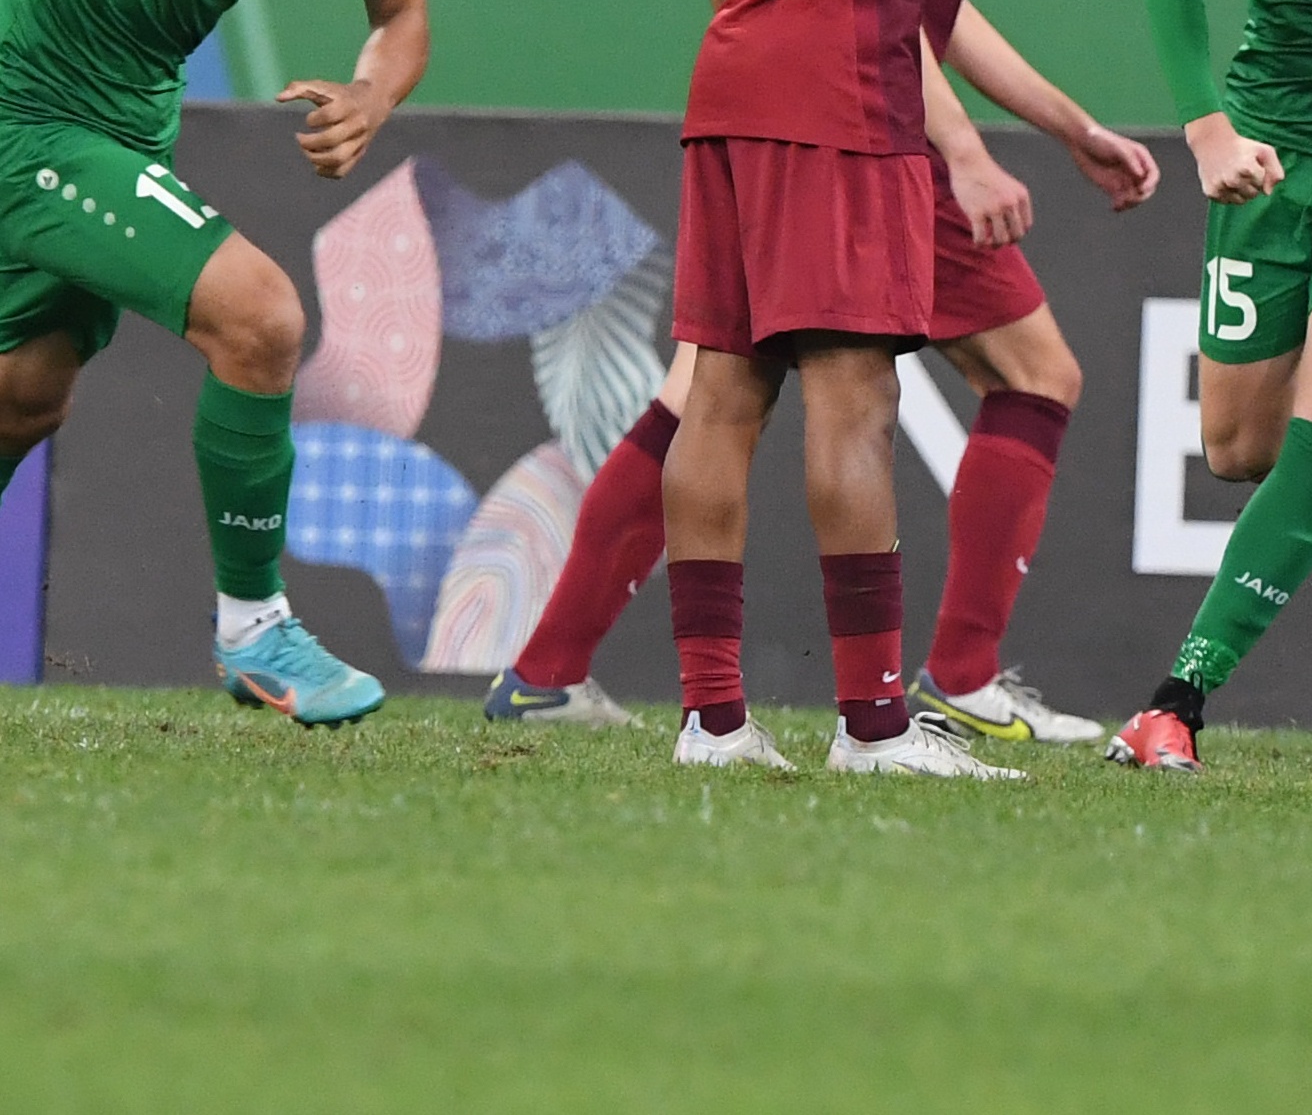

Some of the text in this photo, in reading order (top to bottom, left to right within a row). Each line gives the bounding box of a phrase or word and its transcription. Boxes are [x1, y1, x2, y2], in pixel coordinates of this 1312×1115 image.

[1206, 255, 1258, 341] 15
[217, 511, 283, 531] JAKO
[1234, 571, 1290, 605] JAKO
